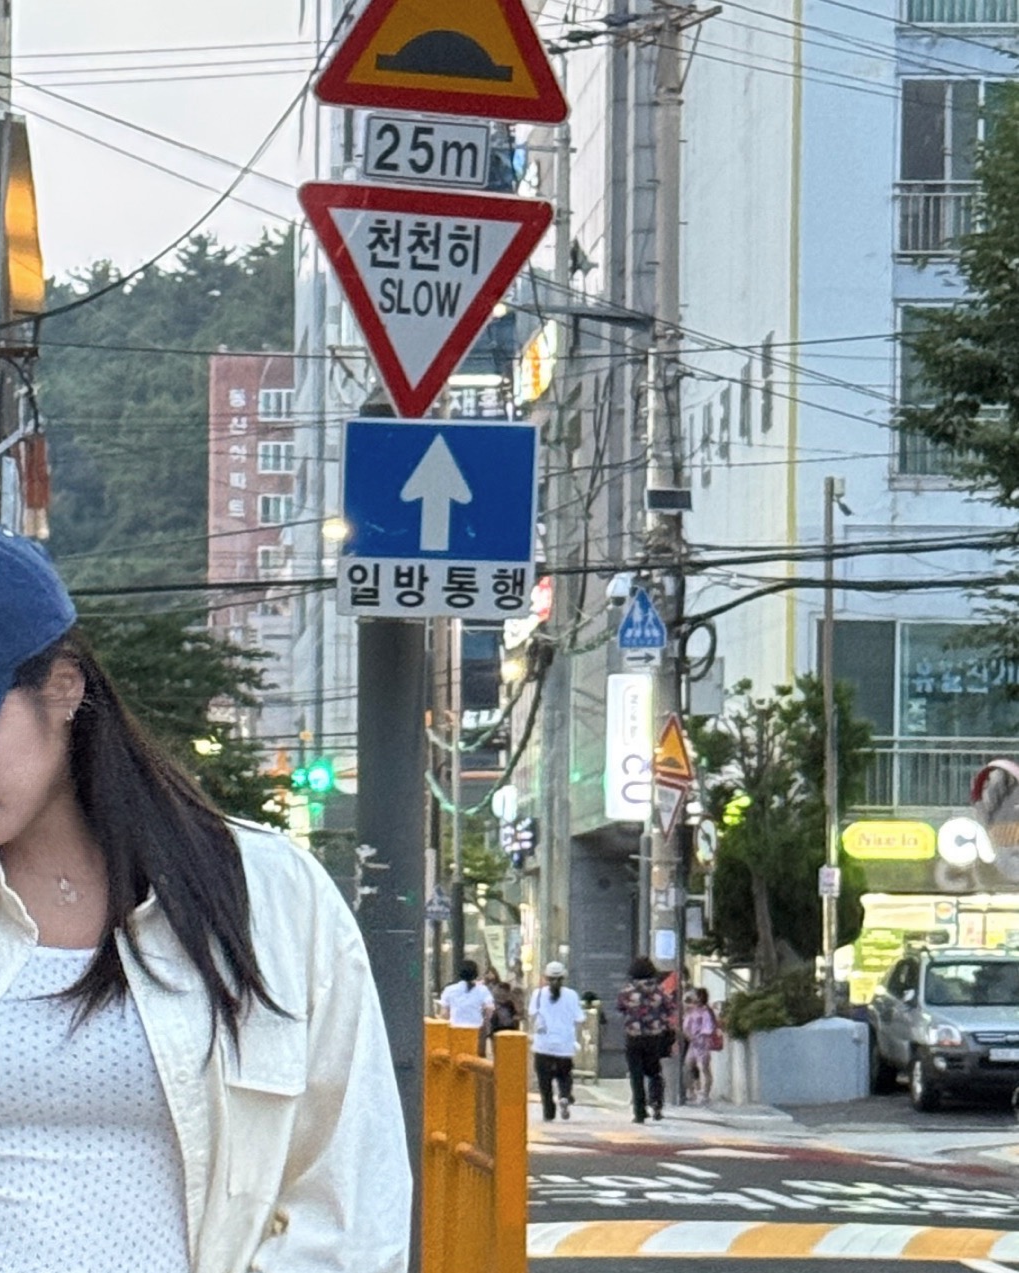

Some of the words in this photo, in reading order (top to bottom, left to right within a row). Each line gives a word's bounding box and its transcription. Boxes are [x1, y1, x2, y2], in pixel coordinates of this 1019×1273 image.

[374, 123, 478, 178] 25m
[367, 219, 481, 275] 천천히
[379, 277, 462, 318] SLOW
[347, 563, 526, 611] 일방통행
